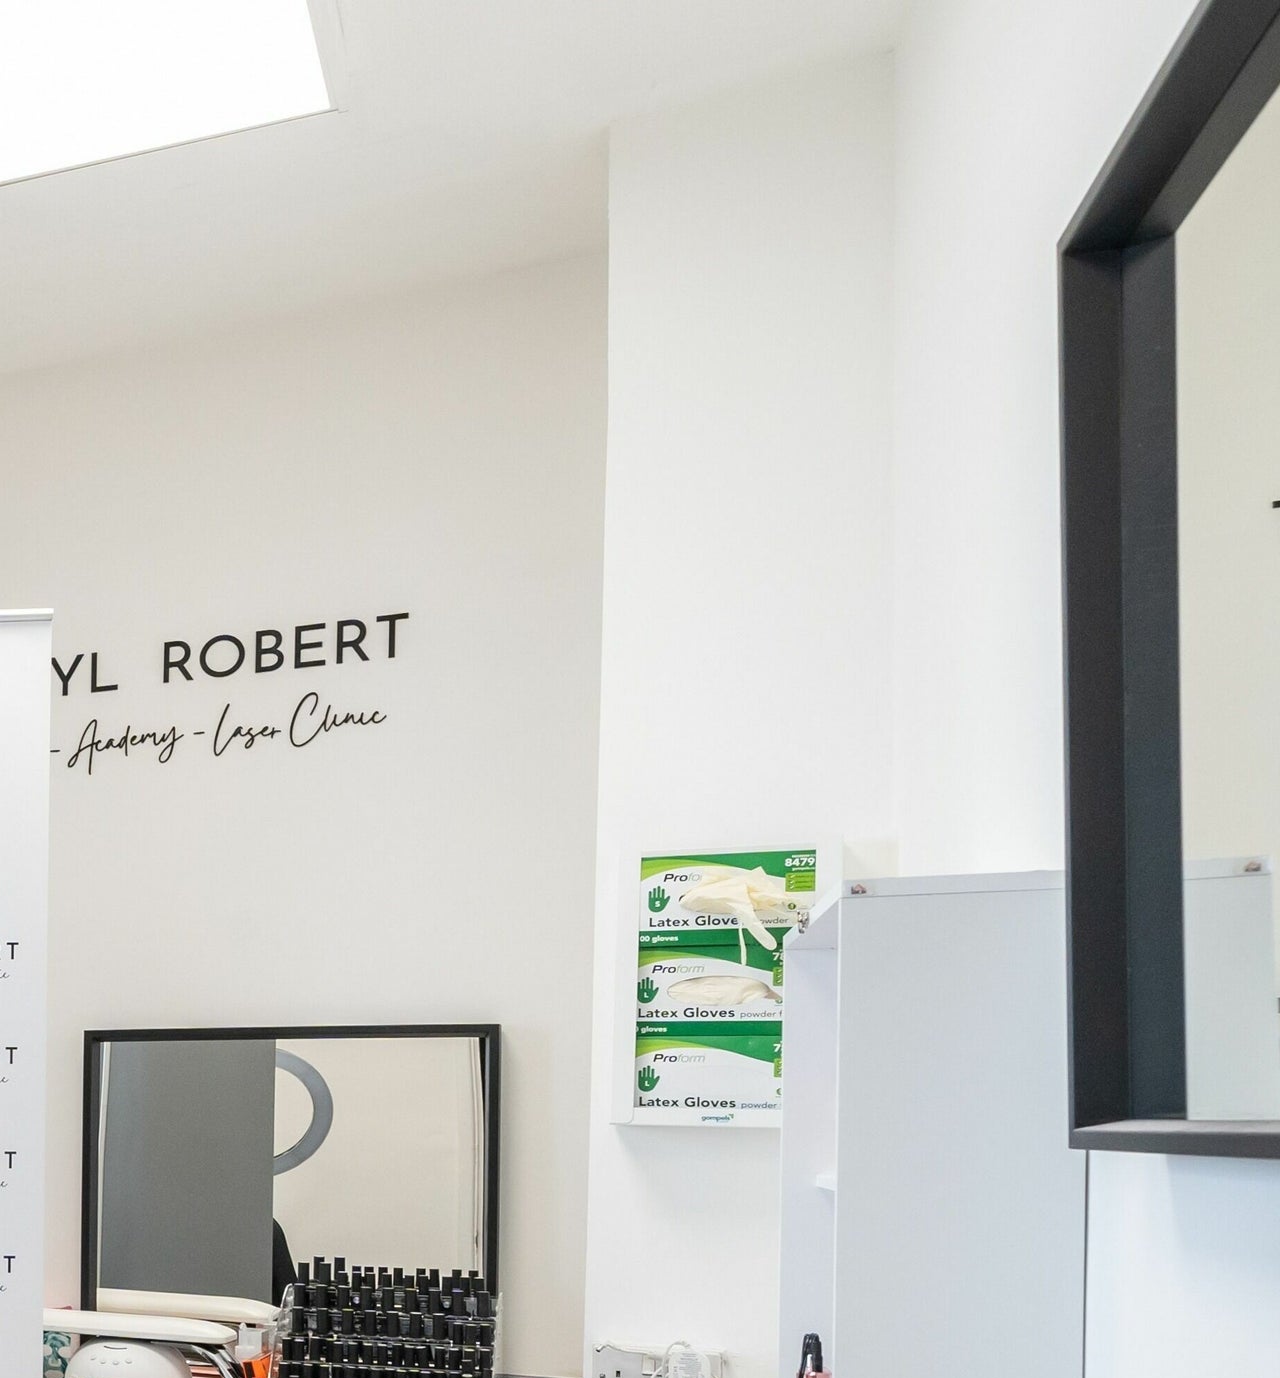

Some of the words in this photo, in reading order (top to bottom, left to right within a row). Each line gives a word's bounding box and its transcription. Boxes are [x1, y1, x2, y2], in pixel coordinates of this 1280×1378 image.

[163, 612, 409, 683] ROBERT
[67, 719, 184, 775] Academy
[213, 704, 281, 756] Laser
[290, 692, 386, 747] Clinic
[649, 917, 689, 927] Latex
[695, 915, 743, 926] Glove
[652, 935, 679, 943] gloves
[652, 964, 705, 974] Proform
[638, 1008, 678, 1018] Latex
[683, 1007, 735, 1018] Gloves
[740, 1010, 776, 1018] powder
[640, 1026, 668, 1034] gloves
[653, 1053, 705, 1062] Proform
[639, 1096, 679, 1107] Latex
[684, 1097, 736, 1108] Gloves
[740, 1101, 777, 1109] powder
